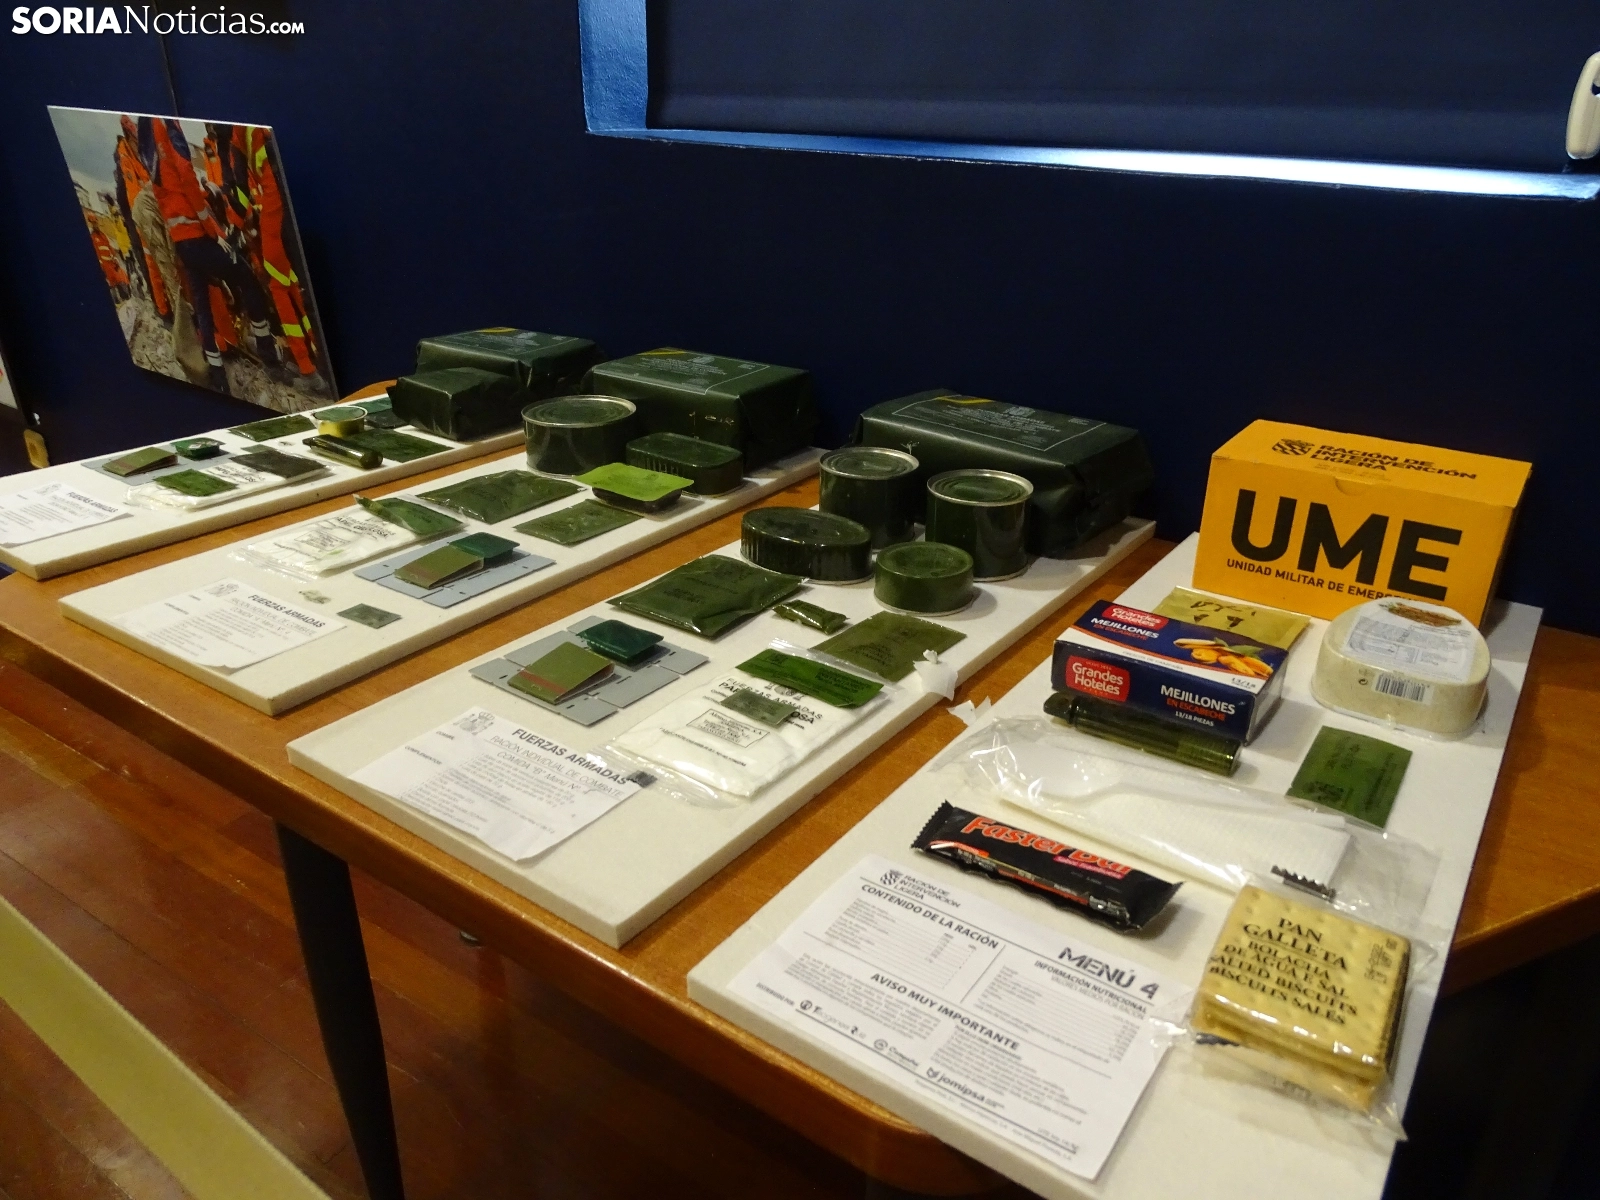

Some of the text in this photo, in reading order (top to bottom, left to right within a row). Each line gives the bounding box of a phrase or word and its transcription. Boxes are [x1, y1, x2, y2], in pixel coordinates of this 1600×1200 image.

[1309, 454, 1388, 472] LIGERA
[1313, 449, 1477, 480] INTERVENCIÓN
[1317, 444, 1435, 466] RACIÓN DE
[1231, 488, 1463, 602] UME
[1227, 558, 1272, 576] UNIDAD
[1275, 569, 1325, 589] MILITAR
[1327, 581, 1345, 593] DE
[248, 594, 326, 628] FUERZAS ARMADAS
[1111, 613, 1156, 628] Hoteles
[1112, 606, 1162, 625] Grandes
[1090, 617, 1160, 639] MEJILLONES
[1072, 662, 1124, 685] Grandes
[1074, 676, 1120, 696] Hoteles
[1160, 685, 1235, 715] MEJILLONES
[1167, 699, 1226, 722] EN ESCABECHE
[1193, 715, 1214, 727] PIEZAS
[496, 751, 531, 769] COMIDA
[512, 728, 627, 786] FUERZAS ARMADAS
[519, 748, 565, 774] INDIVIDUAL
[565, 769, 579, 780] DE
[578, 774, 626, 798] COMBATE
[961, 816, 1069, 855] Faster
[893, 885, 924, 900] LIGERA
[936, 888, 951, 897] DE
[861, 884, 999, 950] CONTENIDO DE LA RACIÓN
[1277, 917, 1324, 943] PAN
[1243, 923, 1348, 972] GALLETA
[1248, 940, 1331, 980] BOLACHA
[1058, 947, 1159, 999] MENÚ 4
[1209, 966, 1288, 1002] BISCUITS
[1223, 943, 1249, 958] DE
[1303, 973, 1314, 985] E
[1317, 979, 1349, 999] SAL
[1035, 960, 1147, 1014] INFORMACIÓN NUTRICIONAL
[1275, 977, 1358, 1017] BISCUITS
[870, 972, 1020, 1050] AVISO MUY IMPORTANTE
[937, 1072, 985, 1102] jomipsa
